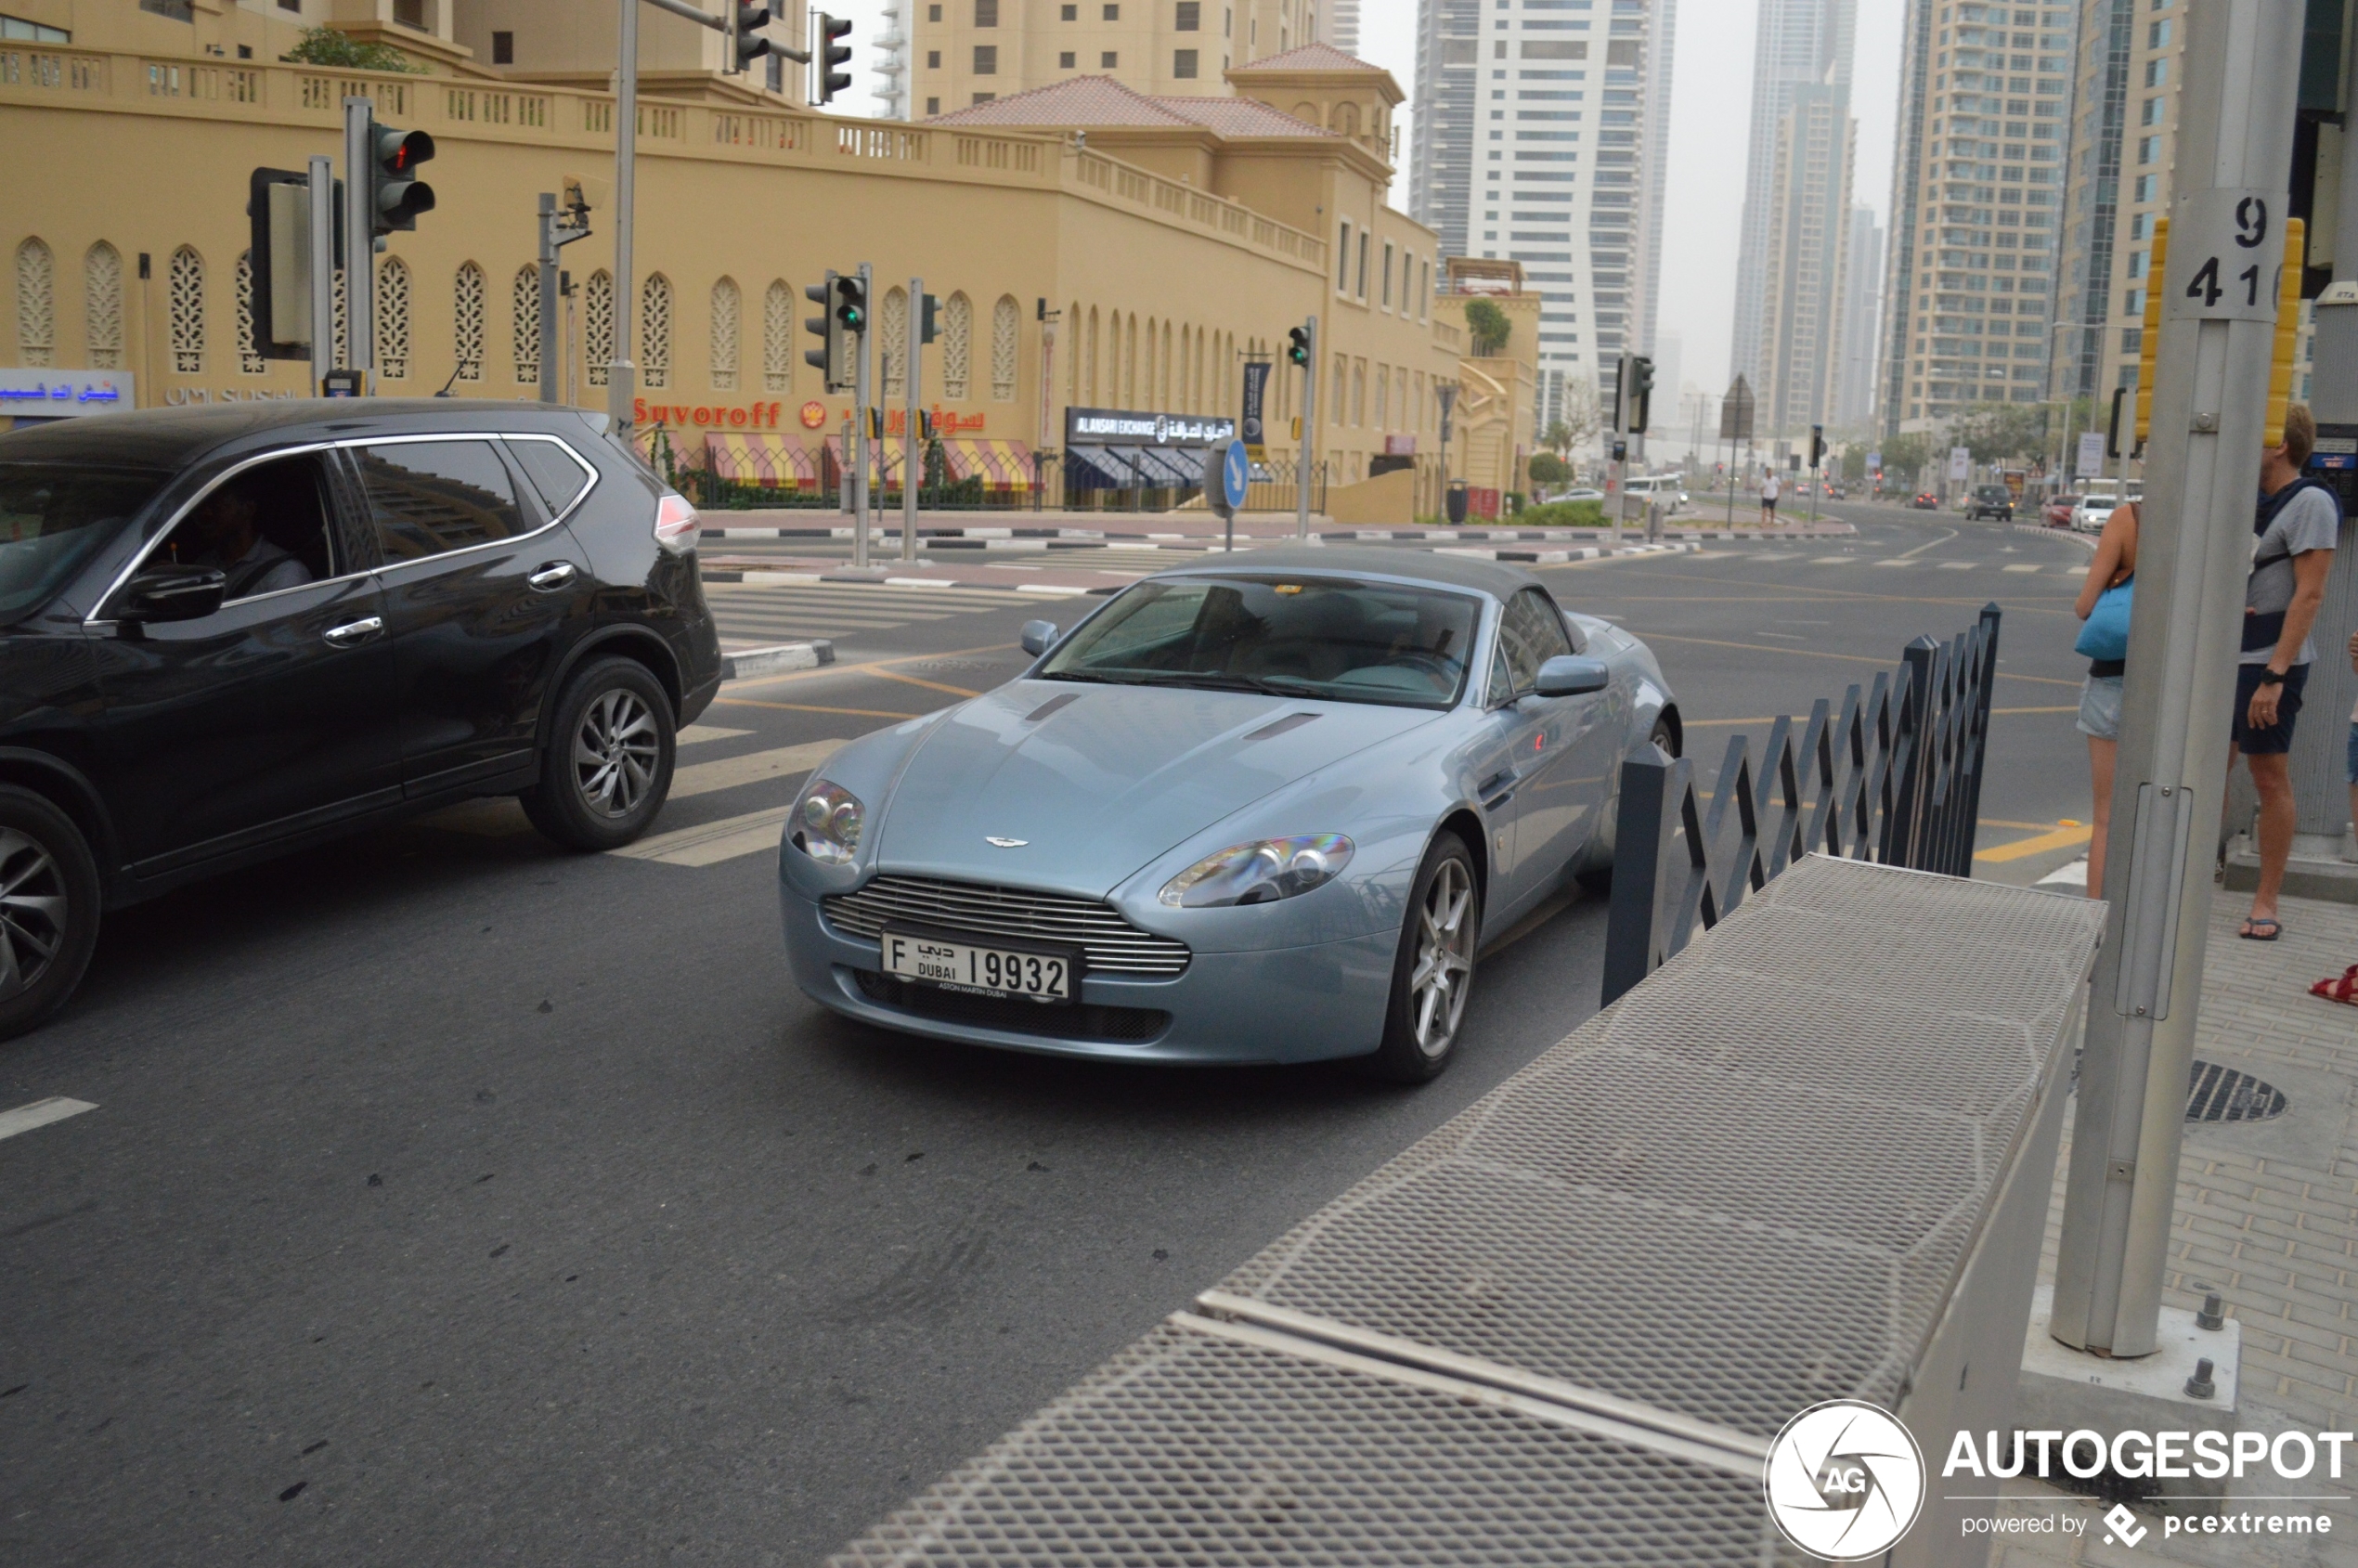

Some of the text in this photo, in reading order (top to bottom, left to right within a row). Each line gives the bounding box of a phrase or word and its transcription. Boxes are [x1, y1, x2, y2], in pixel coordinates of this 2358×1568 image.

[2235, 196, 2267, 249] 9
[2336, 291, 2355, 300] RTA
[634, 396, 783, 428] Suvoroff
[1089, 418, 1119, 434] ANSARI
[1119, 420, 1157, 436] EXCHANGE
[891, 939, 906, 969] F
[918, 962, 956, 980] DUBAI
[969, 950, 1065, 996] 19932
[939, 982, 1007, 998] ASTON MARTIN DUBAI
